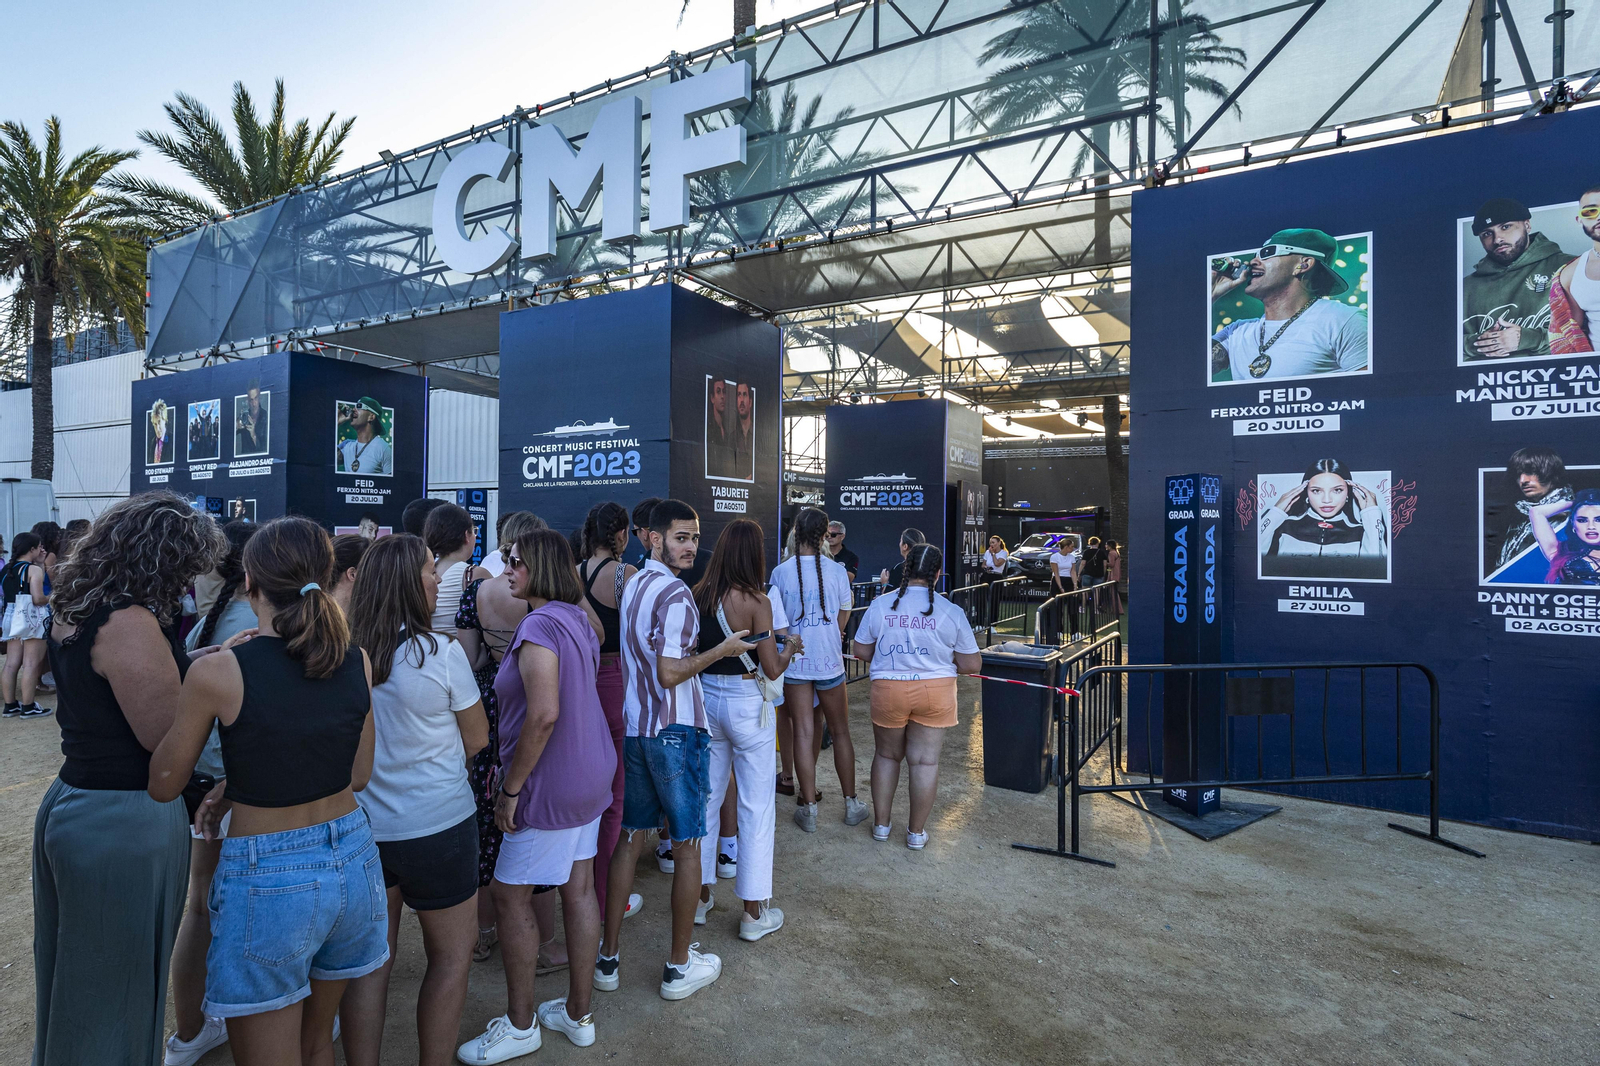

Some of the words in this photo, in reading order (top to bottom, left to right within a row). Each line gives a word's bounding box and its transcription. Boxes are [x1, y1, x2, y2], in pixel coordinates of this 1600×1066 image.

[432, 59, 752, 275] CMF
[1478, 367, 1556, 386] NICKY
[1559, 364, 1600, 381] JA
[1258, 387, 1313, 404] FEID
[1456, 383, 1565, 403] MANUEL
[1211, 405, 1271, 418] FERXXO
[1274, 402, 1325, 414] NITRO
[1327, 399, 1365, 411] JAM
[1511, 404, 1538, 417] 07
[1247, 422, 1269, 432] 20
[1272, 418, 1325, 430] JULIO
[522, 444, 563, 454] CONCERT
[565, 441, 593, 452] MUSIC
[595, 438, 640, 450] FESTIVAL
[189, 464, 206, 472] SIMPLY
[229, 459, 259, 469] ALEJANDRO
[259, 457, 274, 466] SANZ
[522, 450, 641, 480] CMF2023
[355, 479, 375, 488] FEID
[783, 471, 797, 483] CMF
[711, 486, 749, 499] TABURETE
[840, 492, 924, 506] CMF2023
[716, 502, 723, 510] 07
[724, 502, 745, 511] AGOSTO
[1168, 510, 1195, 520] GRADA
[1200, 508, 1220, 519] GRADA
[1173, 525, 1188, 624] GRADA
[1204, 524, 1216, 624] GRADA
[1288, 585, 1354, 599] EMILIA
[1477, 591, 1550, 605] DANNY
[1552, 594, 1600, 608] OCE
[1290, 602, 1307, 611] 27
[1308, 603, 1351, 613] JULIO
[1491, 604, 1535, 617] LALI
[884, 614, 937, 631] TEAM
[1511, 621, 1533, 631] 02
[1171, 788, 1187, 798] CMF
[1203, 789, 1215, 801] CMF
